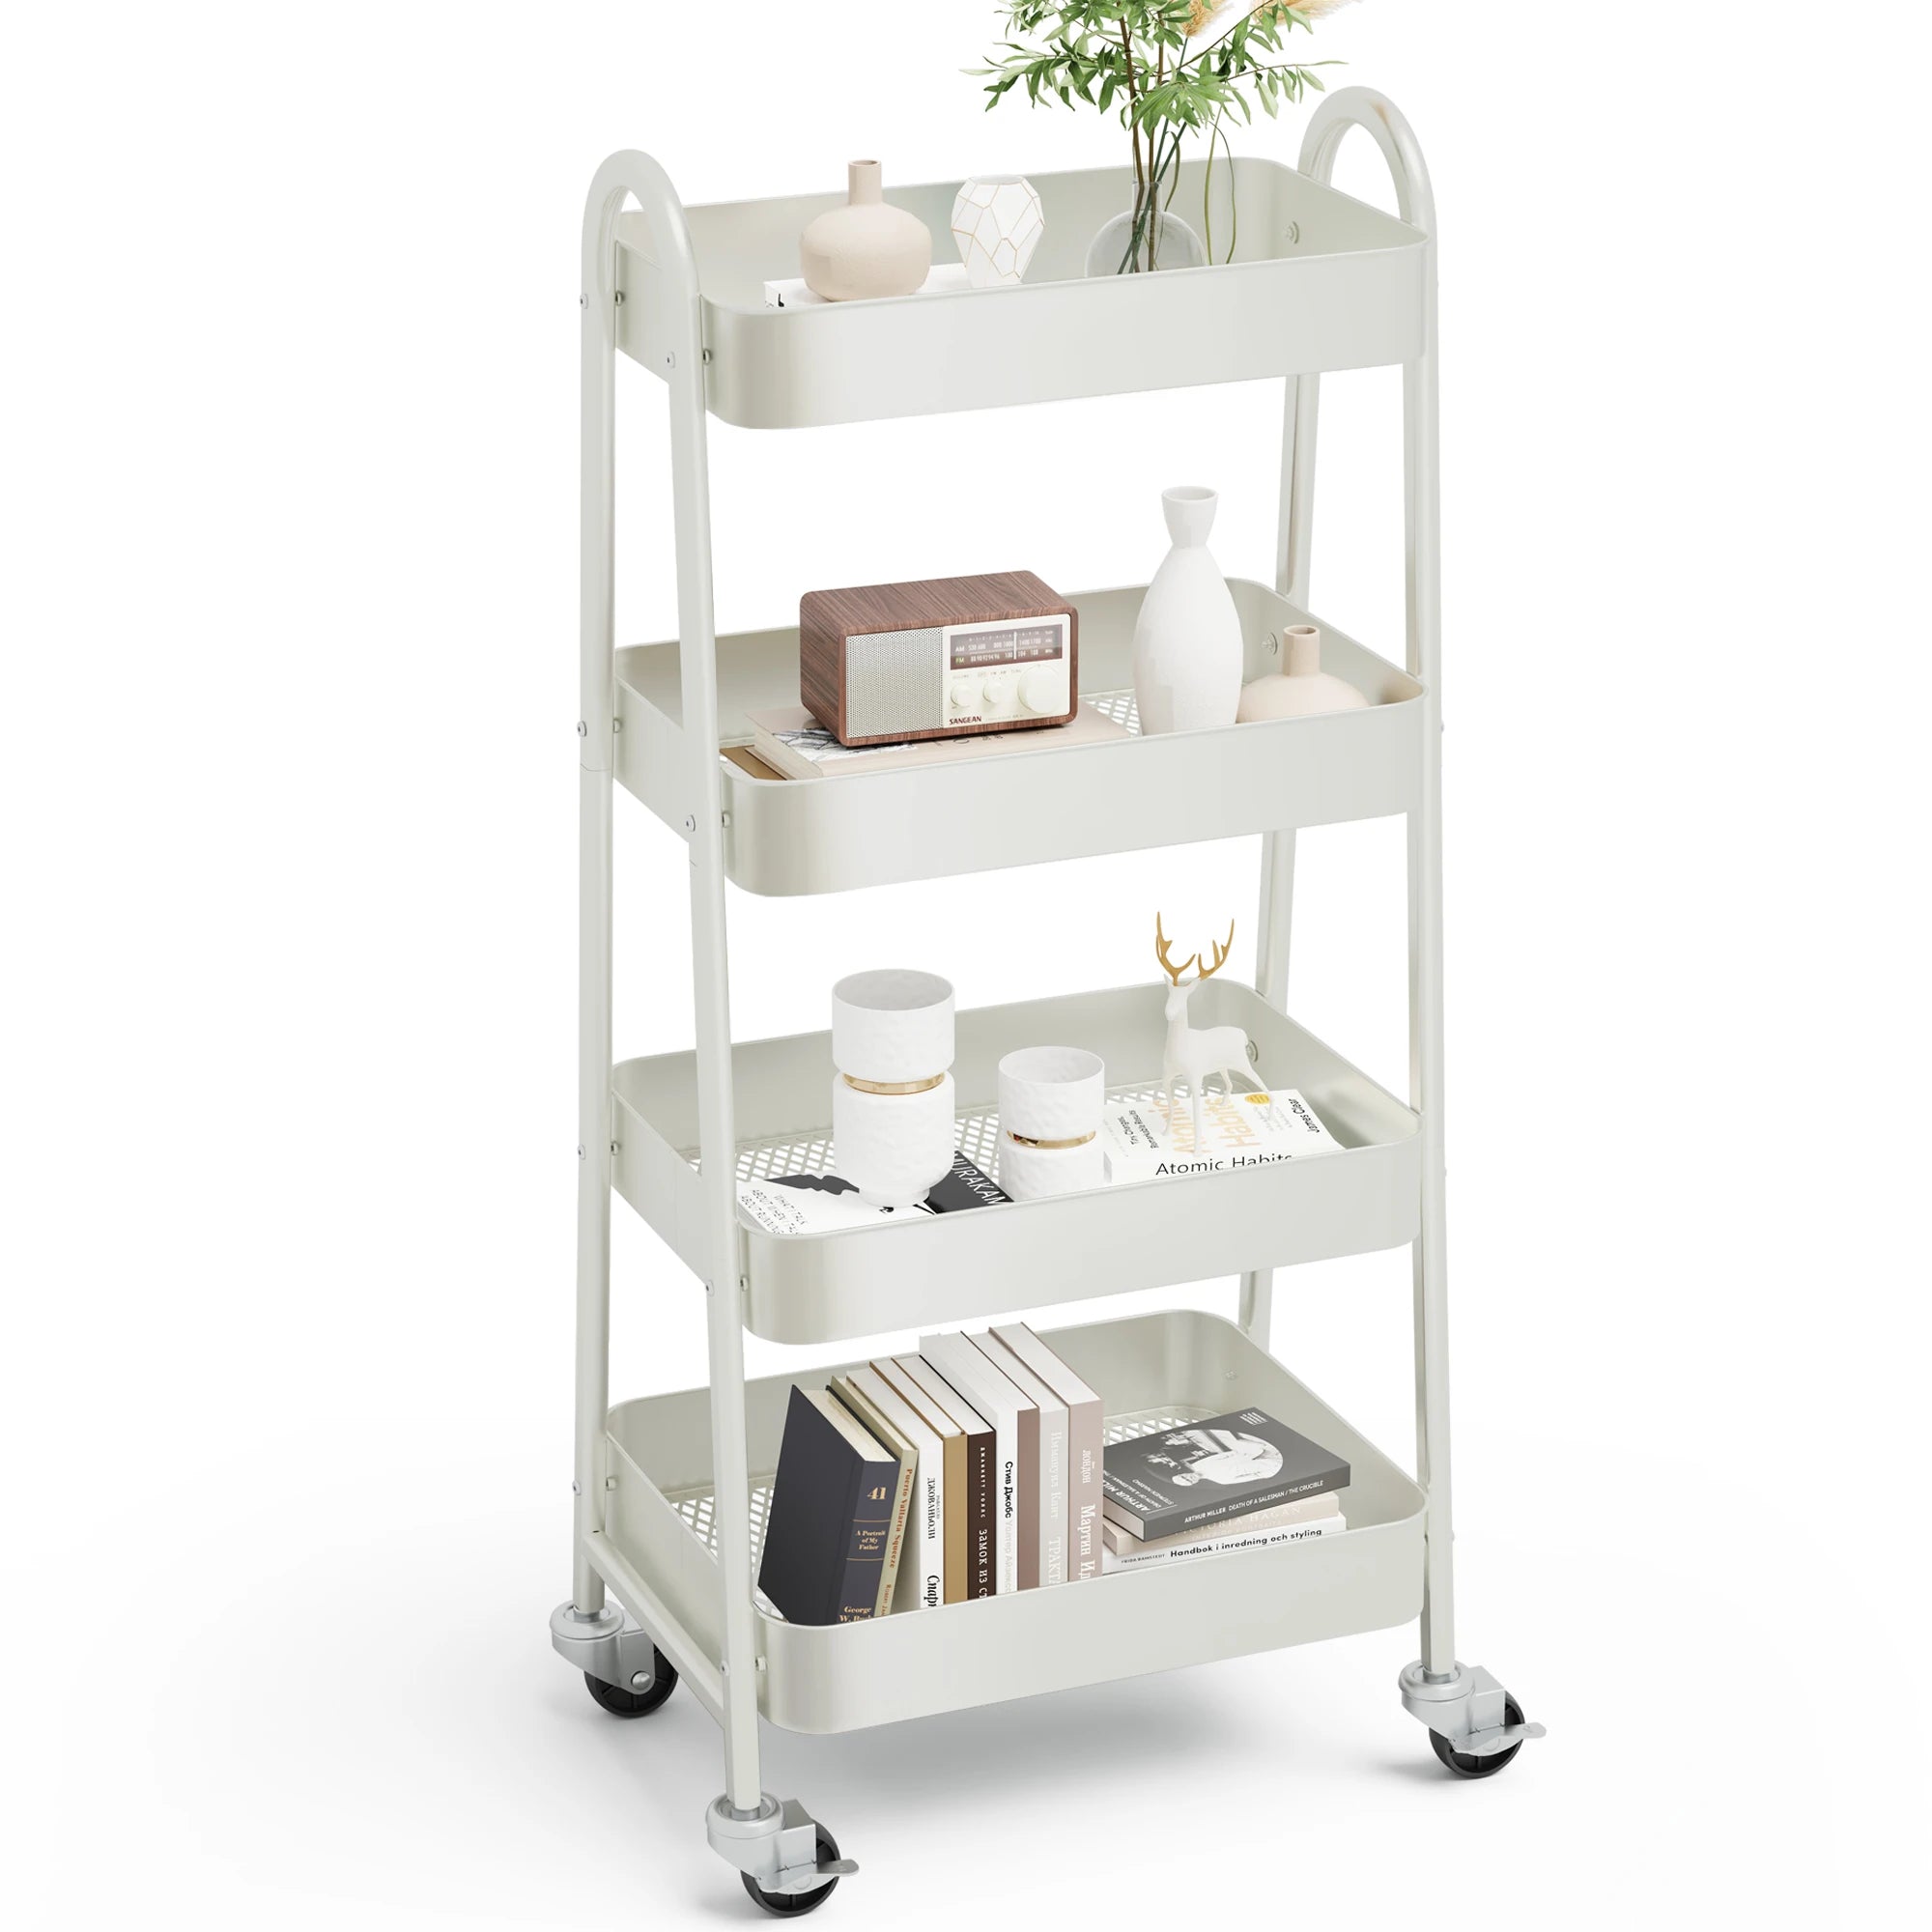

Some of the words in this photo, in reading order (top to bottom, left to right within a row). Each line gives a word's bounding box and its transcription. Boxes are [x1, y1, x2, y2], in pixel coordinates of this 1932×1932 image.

[949, 716, 981, 724] SANGEAN
[1155, 1158, 1224, 1175] Atomic
[902, 1467, 913, 1496] Puerto
[1005, 1462, 1013, 1485] Стив
[867, 1487, 887, 1499] 41
[1004, 1487, 1013, 1519] Джобс
[1116, 1491, 1151, 1511] ARTHUR
[1184, 1512, 1207, 1523] ARTHUR
[1207, 1507, 1226, 1518] MILLER
[1228, 1501, 1245, 1511] DEATH
[1258, 1492, 1285, 1503] SALESMAN
[1289, 1487, 1299, 1495] THE
[1299, 1480, 1323, 1492] CRUCIBLE
[896, 1498, 908, 1532] Vallarta
[1077, 1504, 1095, 1556] Мартин
[1170, 1544, 1212, 1557] Handbok
[1222, 1537, 1267, 1549] inredning
[1270, 1533, 1288, 1543] och
[1291, 1529, 1322, 1541] styling
[890, 1534, 901, 1568] Squeeze
[843, 1605, 872, 1614] George
